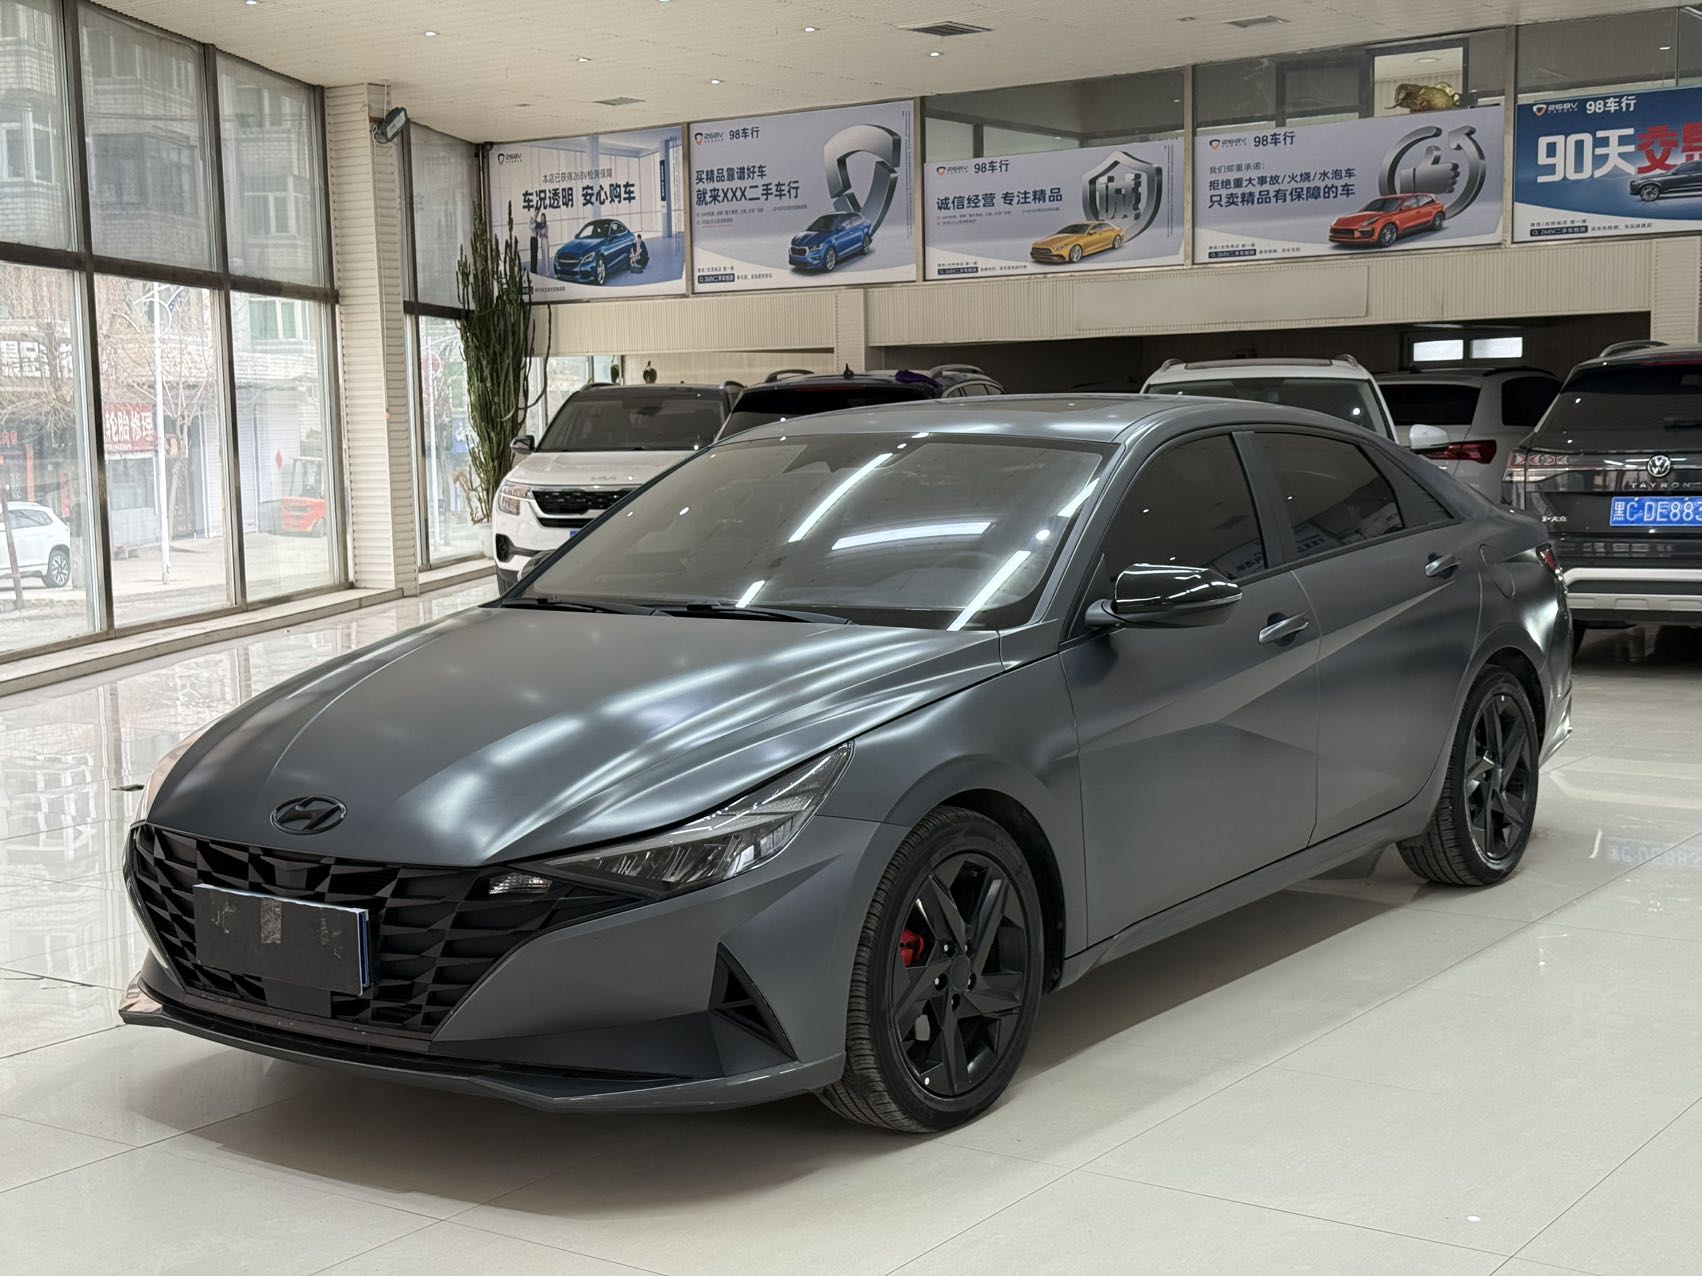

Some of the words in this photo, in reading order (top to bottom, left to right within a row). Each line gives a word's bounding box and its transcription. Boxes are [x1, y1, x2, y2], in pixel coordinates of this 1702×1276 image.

[1586, 95, 1637, 114] 98车行
[729, 126, 760, 140] 98车行
[1253, 131, 1295, 147] 98车行
[695, 164, 767, 185] 买精品靠谱好车
[974, 159, 1009, 174] 98车行
[1208, 168, 1356, 191] 拒绝重大事故/火烧/水泡车
[522, 187, 574, 212] 车况透明
[581, 181, 636, 207] 安心购车
[695, 180, 800, 206] 就来XXX二手车行
[936, 192, 996, 211] 诚信经营
[1001, 187, 1063, 206] 专注精品
[1207, 183, 1356, 209] 只卖精品有保障的车
